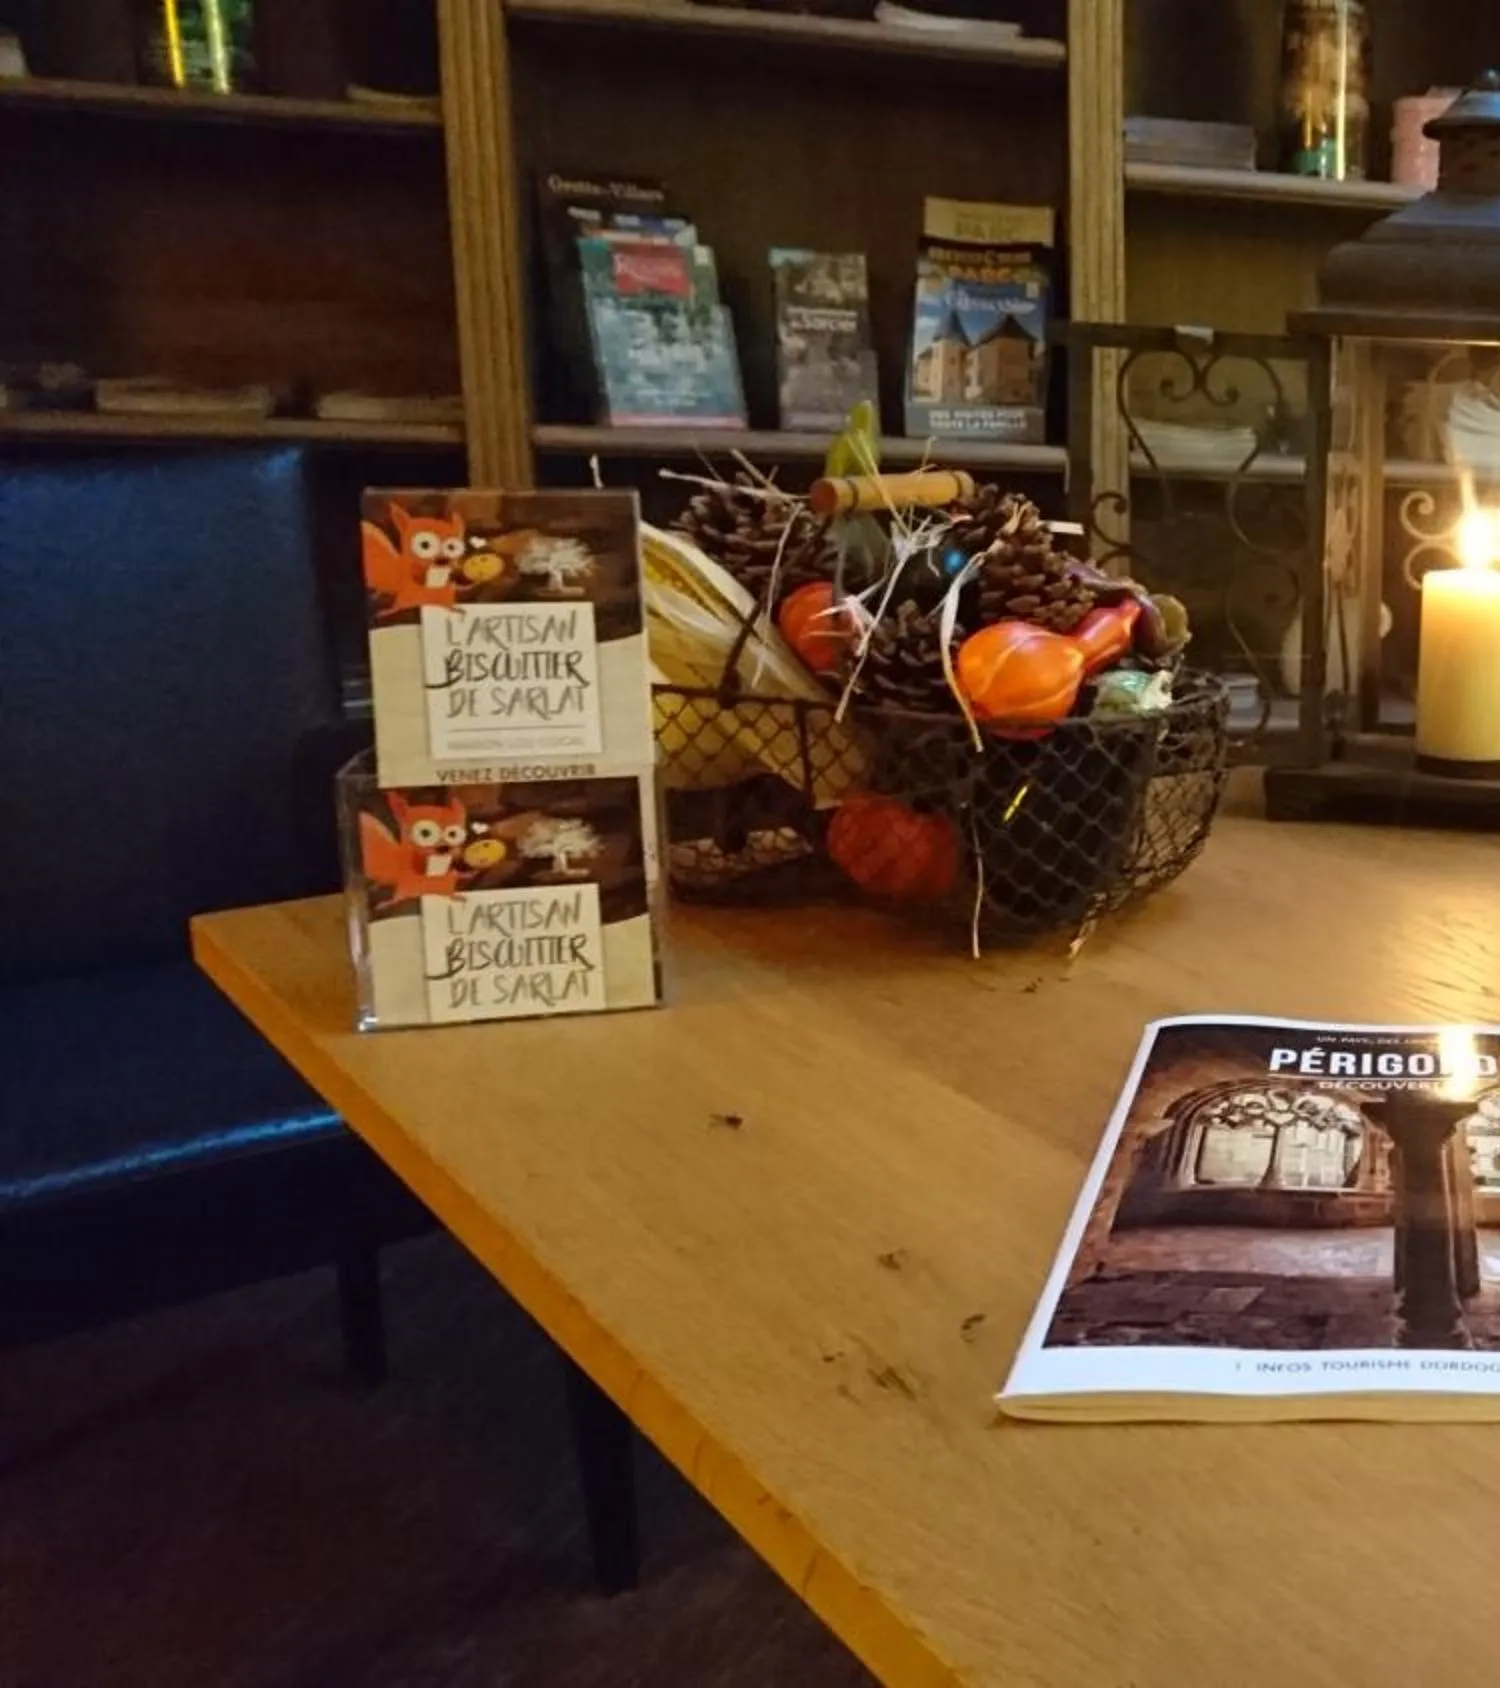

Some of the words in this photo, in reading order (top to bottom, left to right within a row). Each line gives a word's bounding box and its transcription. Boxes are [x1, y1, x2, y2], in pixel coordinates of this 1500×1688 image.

[447, 688, 479, 718] DE
[490, 686, 584, 720] SARLAT
[436, 768, 493, 782] VENEZ
[500, 763, 596, 780] DÉCOUVRIR
[449, 976, 480, 1008] DE
[493, 970, 591, 1006] SARLAT
[1319, 1080, 1459, 1091] DÉCOUVERT
[1256, 1362, 1312, 1374] INFOS
[1321, 1359, 1412, 1372] TOURISME
